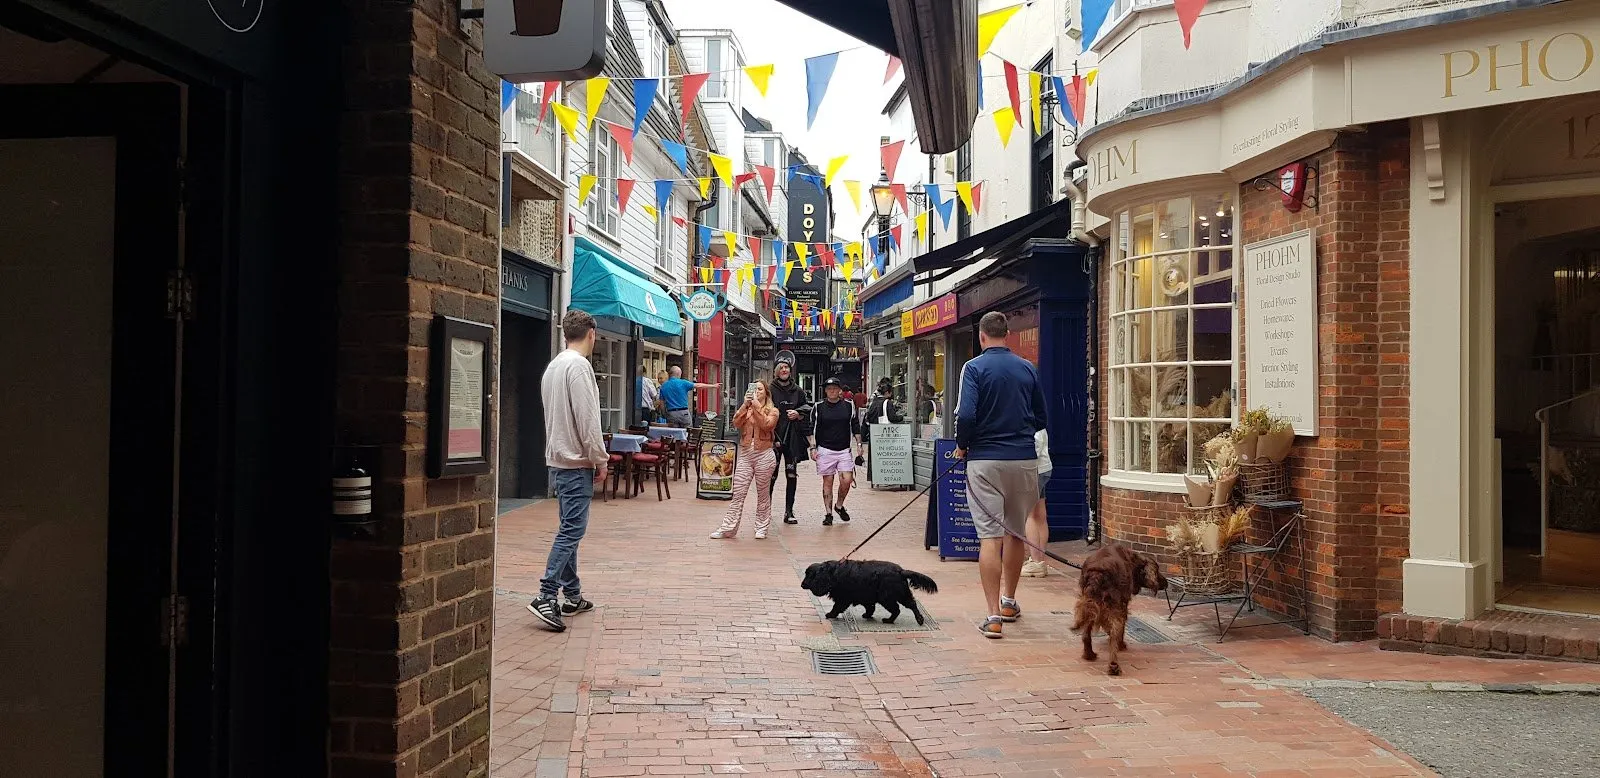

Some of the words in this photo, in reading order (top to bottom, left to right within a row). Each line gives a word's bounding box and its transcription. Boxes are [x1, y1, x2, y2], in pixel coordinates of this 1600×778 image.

[1440, 32, 1594, 98] PHO
[1232, 134, 1261, 154] Everlasting
[1261, 123, 1278, 140] Floral
[1279, 116, 1299, 134] Styling
[802, 203, 815, 283] DOYLS
[1256, 243, 1300, 271] PHOHM
[1256, 275, 1269, 286] Floral
[1269, 273, 1285, 285] Design
[1286, 269, 1300, 281] Studio
[1260, 297, 1275, 309] Dried
[1275, 296, 1297, 307] Flowers
[1263, 314, 1295, 325] Homewares
[1264, 329, 1294, 341] Workshops
[1270, 347, 1288, 356] Events
[1261, 363, 1279, 372] Interior
[1281, 361, 1299, 374] Styling
[1264, 379, 1295, 389] Installations
